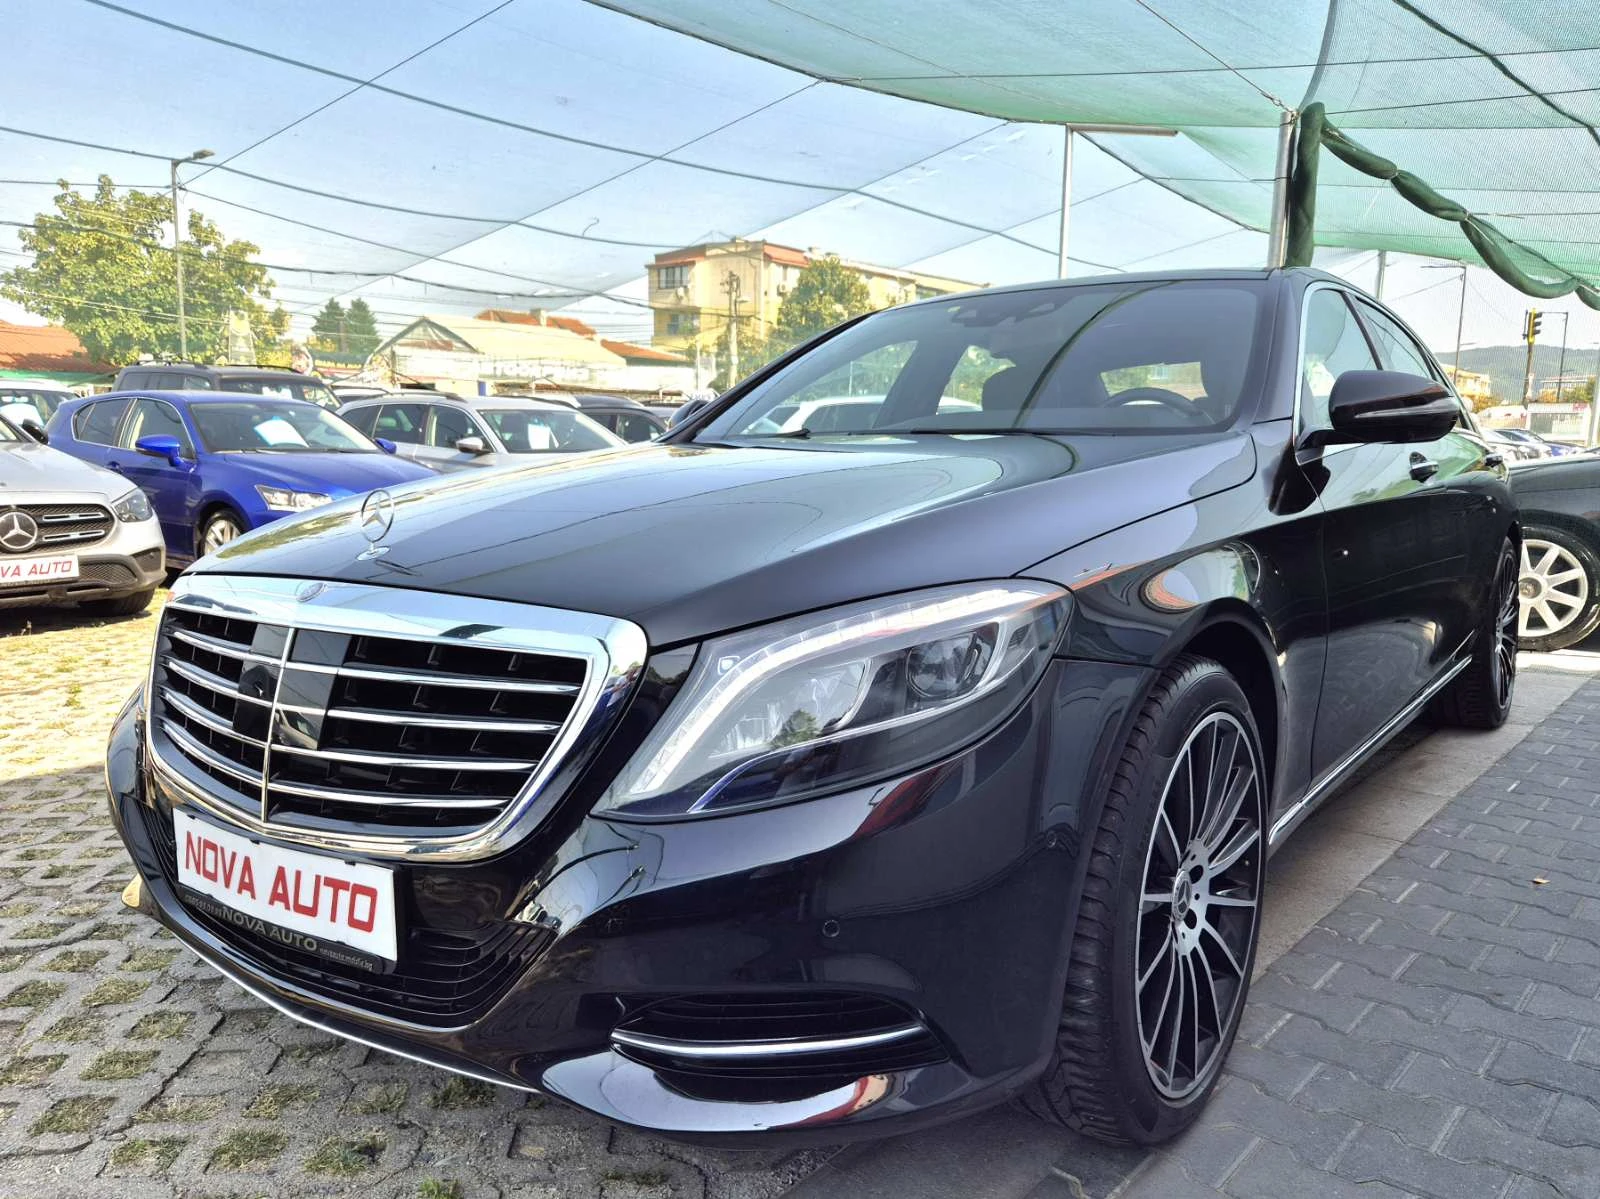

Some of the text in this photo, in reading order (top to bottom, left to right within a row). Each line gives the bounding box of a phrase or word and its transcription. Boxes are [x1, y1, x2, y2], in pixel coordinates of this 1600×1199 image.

[28, 560, 73, 576] AUTO
[185, 830, 379, 933] NOVA AUTO
[222, 906, 266, 935] NOVA
[269, 925, 318, 951] AUTO
